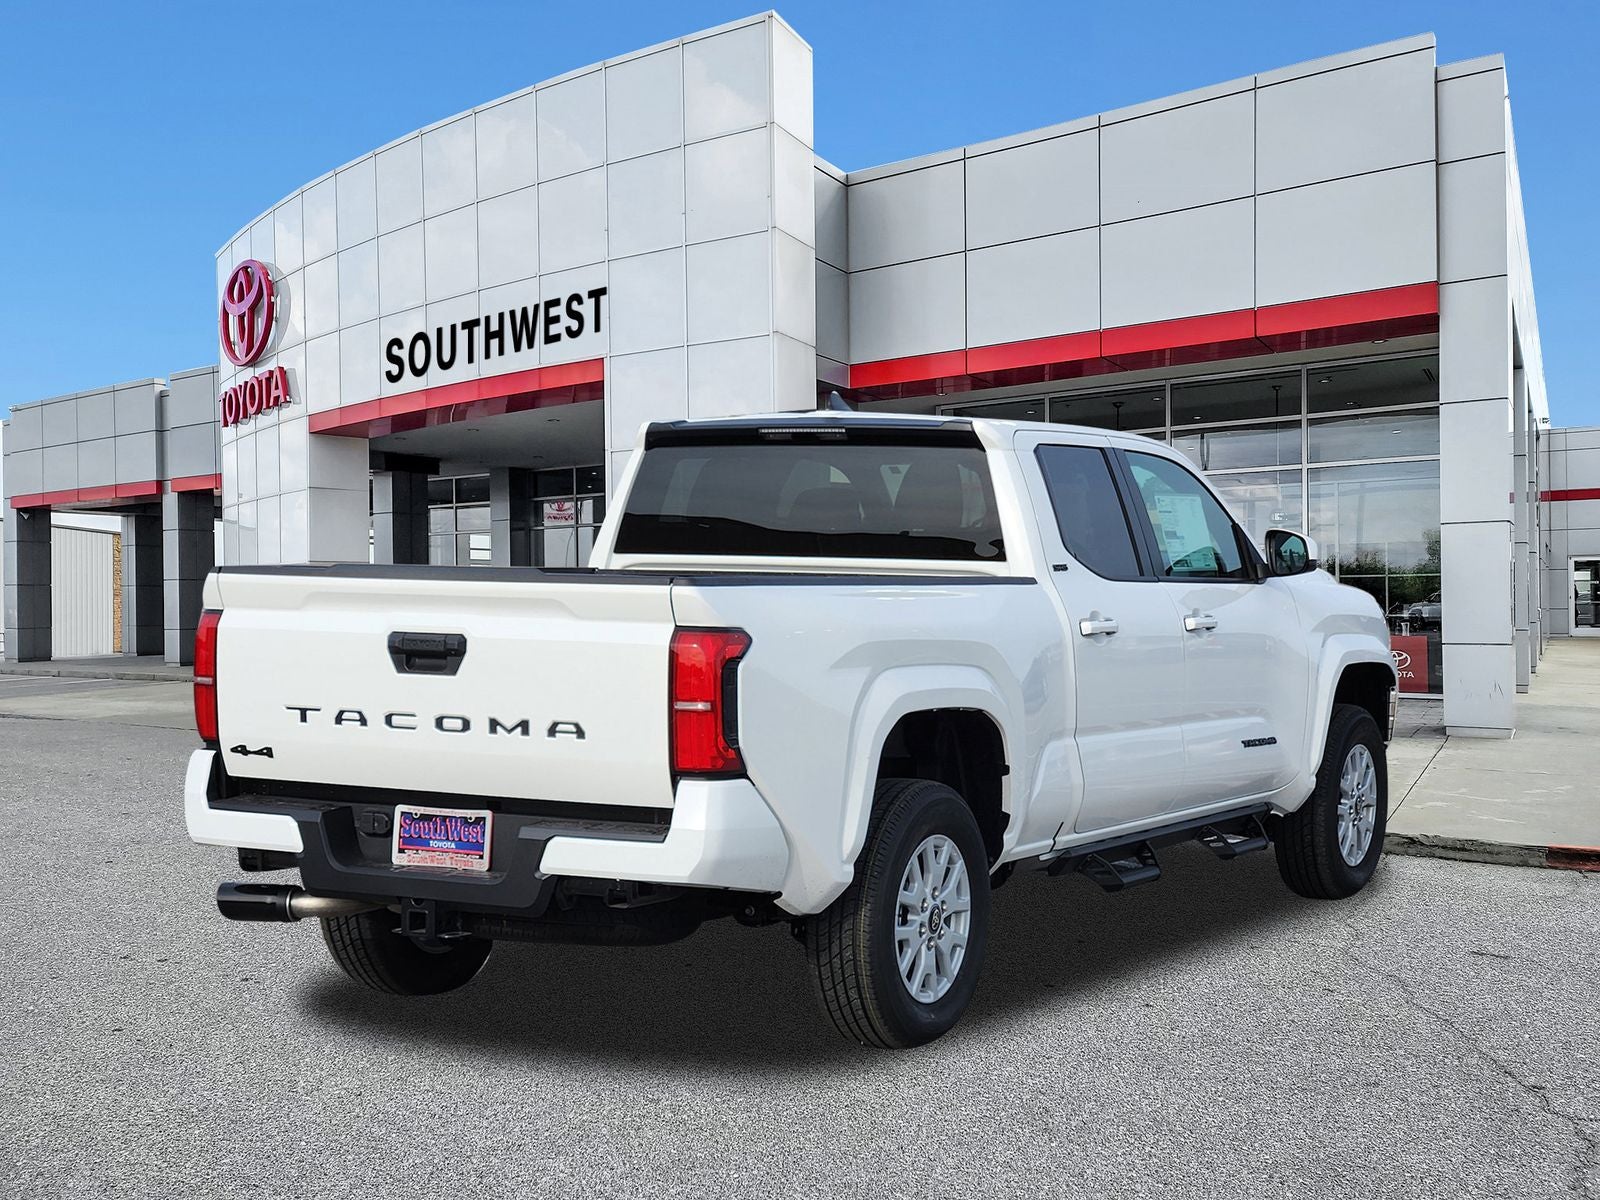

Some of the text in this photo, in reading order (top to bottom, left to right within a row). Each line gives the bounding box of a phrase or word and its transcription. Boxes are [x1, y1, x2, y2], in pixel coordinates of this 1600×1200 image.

[385, 286, 607, 383] SOUTHWEST
[218, 366, 291, 427] TOYOTA
[285, 705, 586, 740] TACOMA
[400, 813, 484, 843] SouthWest
[429, 840, 456, 849] TOYOTA
